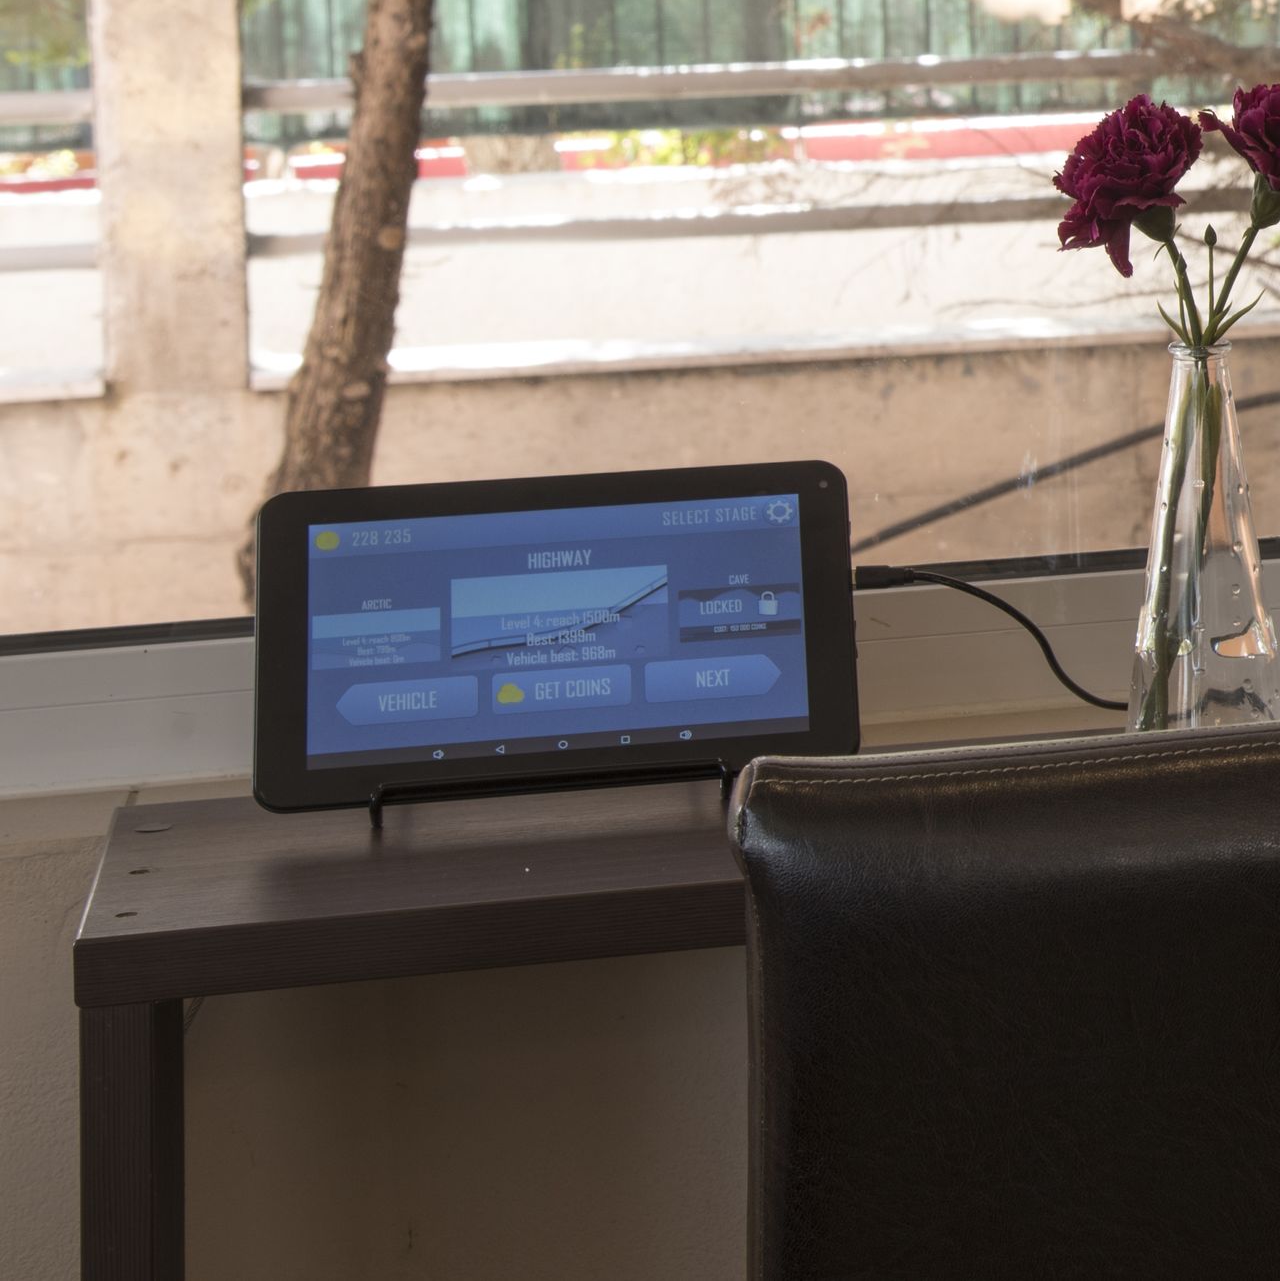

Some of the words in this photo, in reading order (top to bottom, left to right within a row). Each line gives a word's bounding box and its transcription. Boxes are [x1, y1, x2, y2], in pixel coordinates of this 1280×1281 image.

[662, 509, 710, 526] SELECT
[715, 506, 757, 523] STAGE
[352, 530, 378, 546] 228
[384, 528, 411, 545] 235
[528, 549, 592, 569] HIGHWAY
[728, 574, 750, 585] CAVE
[361, 598, 392, 611] ARCTIC
[700, 599, 743, 615] LOCKED
[501, 616, 530, 631] Level
[533, 615, 544, 628] 4:
[546, 611, 580, 627] reach
[583, 610, 620, 624] 1500m
[527, 632, 555, 647] Best:
[558, 629, 596, 644] 1399m
[507, 651, 547, 667] Vehicle
[551, 647, 579, 663] best:
[582, 645, 616, 660] 968m
[696, 669, 731, 688] NEXT
[535, 681, 561, 700] GET
[566, 678, 611, 698] COINS
[378, 690, 437, 712] VEHICLE
